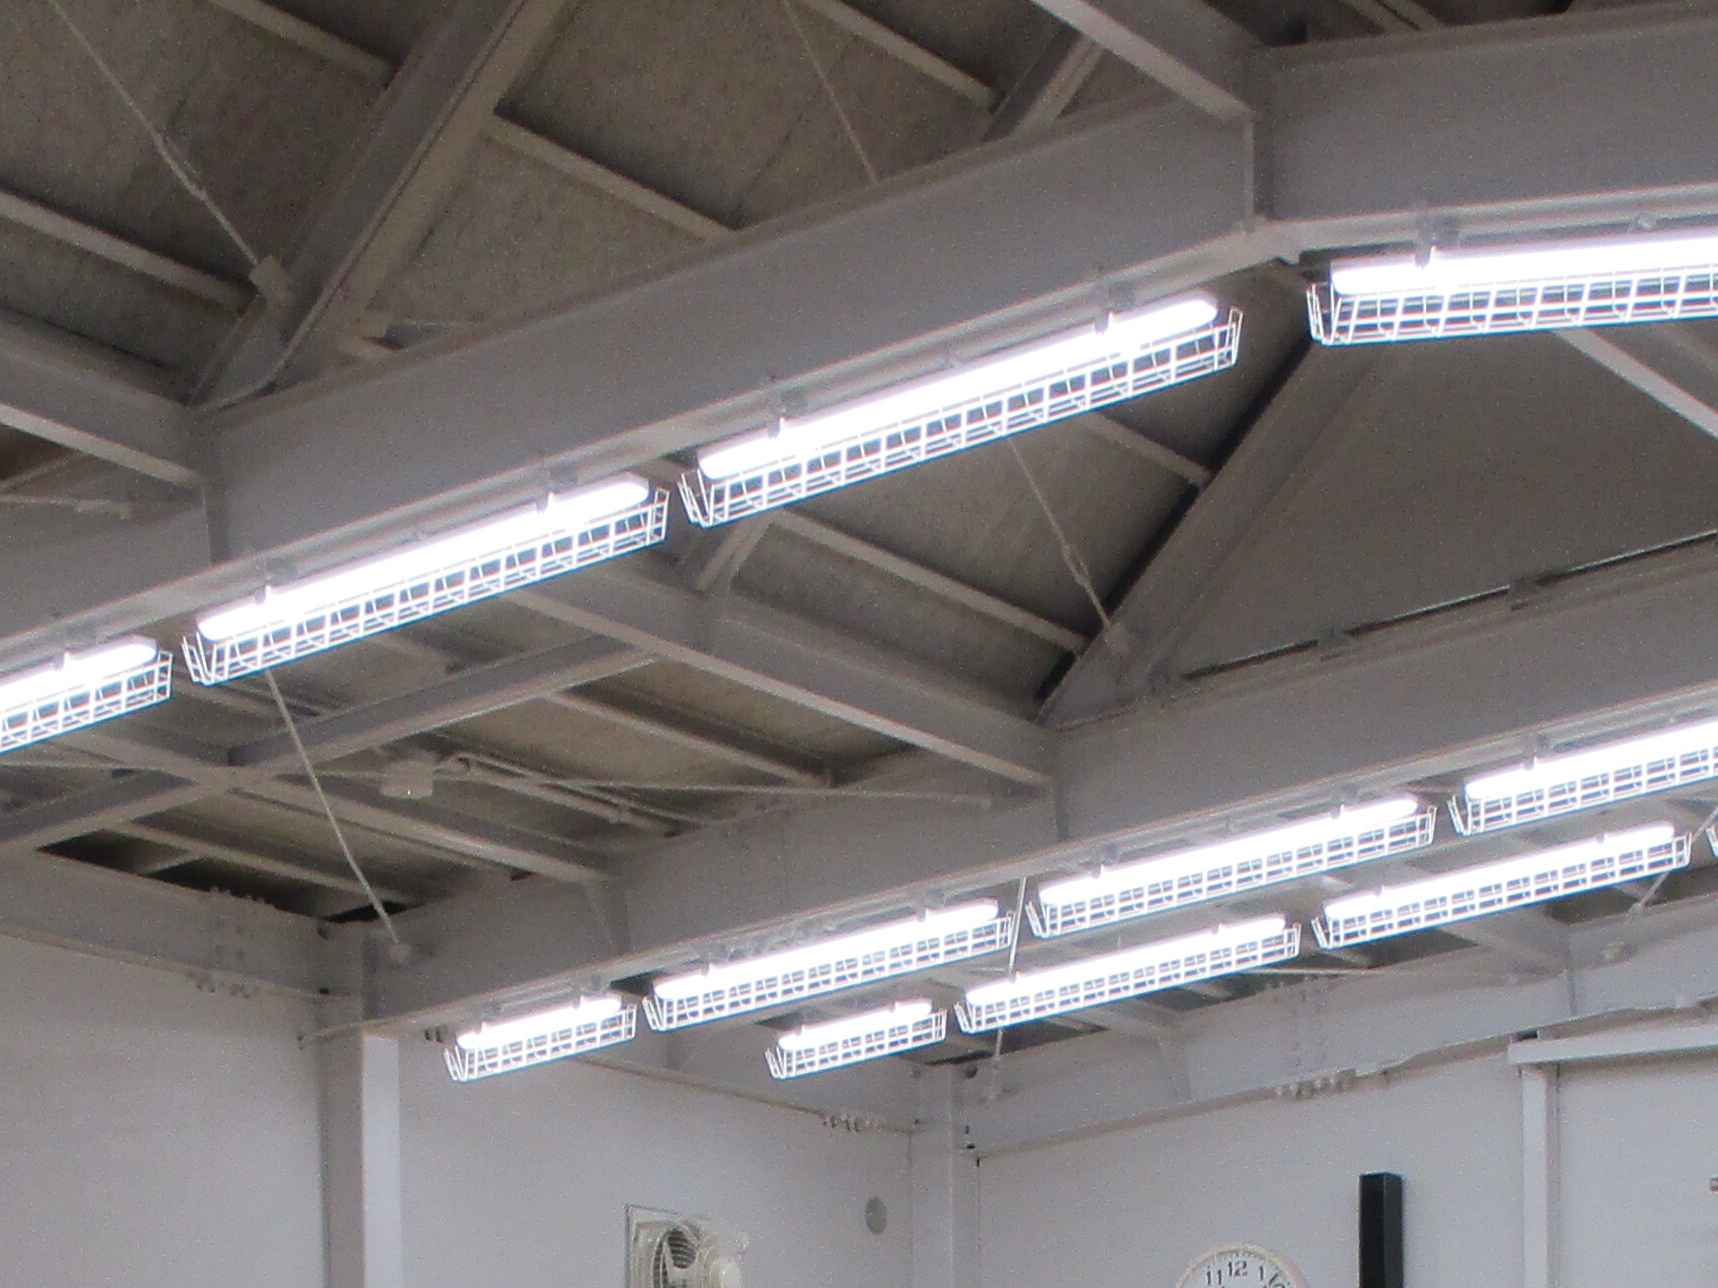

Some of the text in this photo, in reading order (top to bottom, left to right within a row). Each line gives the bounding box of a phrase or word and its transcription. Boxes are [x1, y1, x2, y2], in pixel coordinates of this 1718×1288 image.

[1227, 1260, 1248, 1277] 12
[1258, 1265, 1265, 1281] 1
[1205, 1269, 1222, 1286] 11
